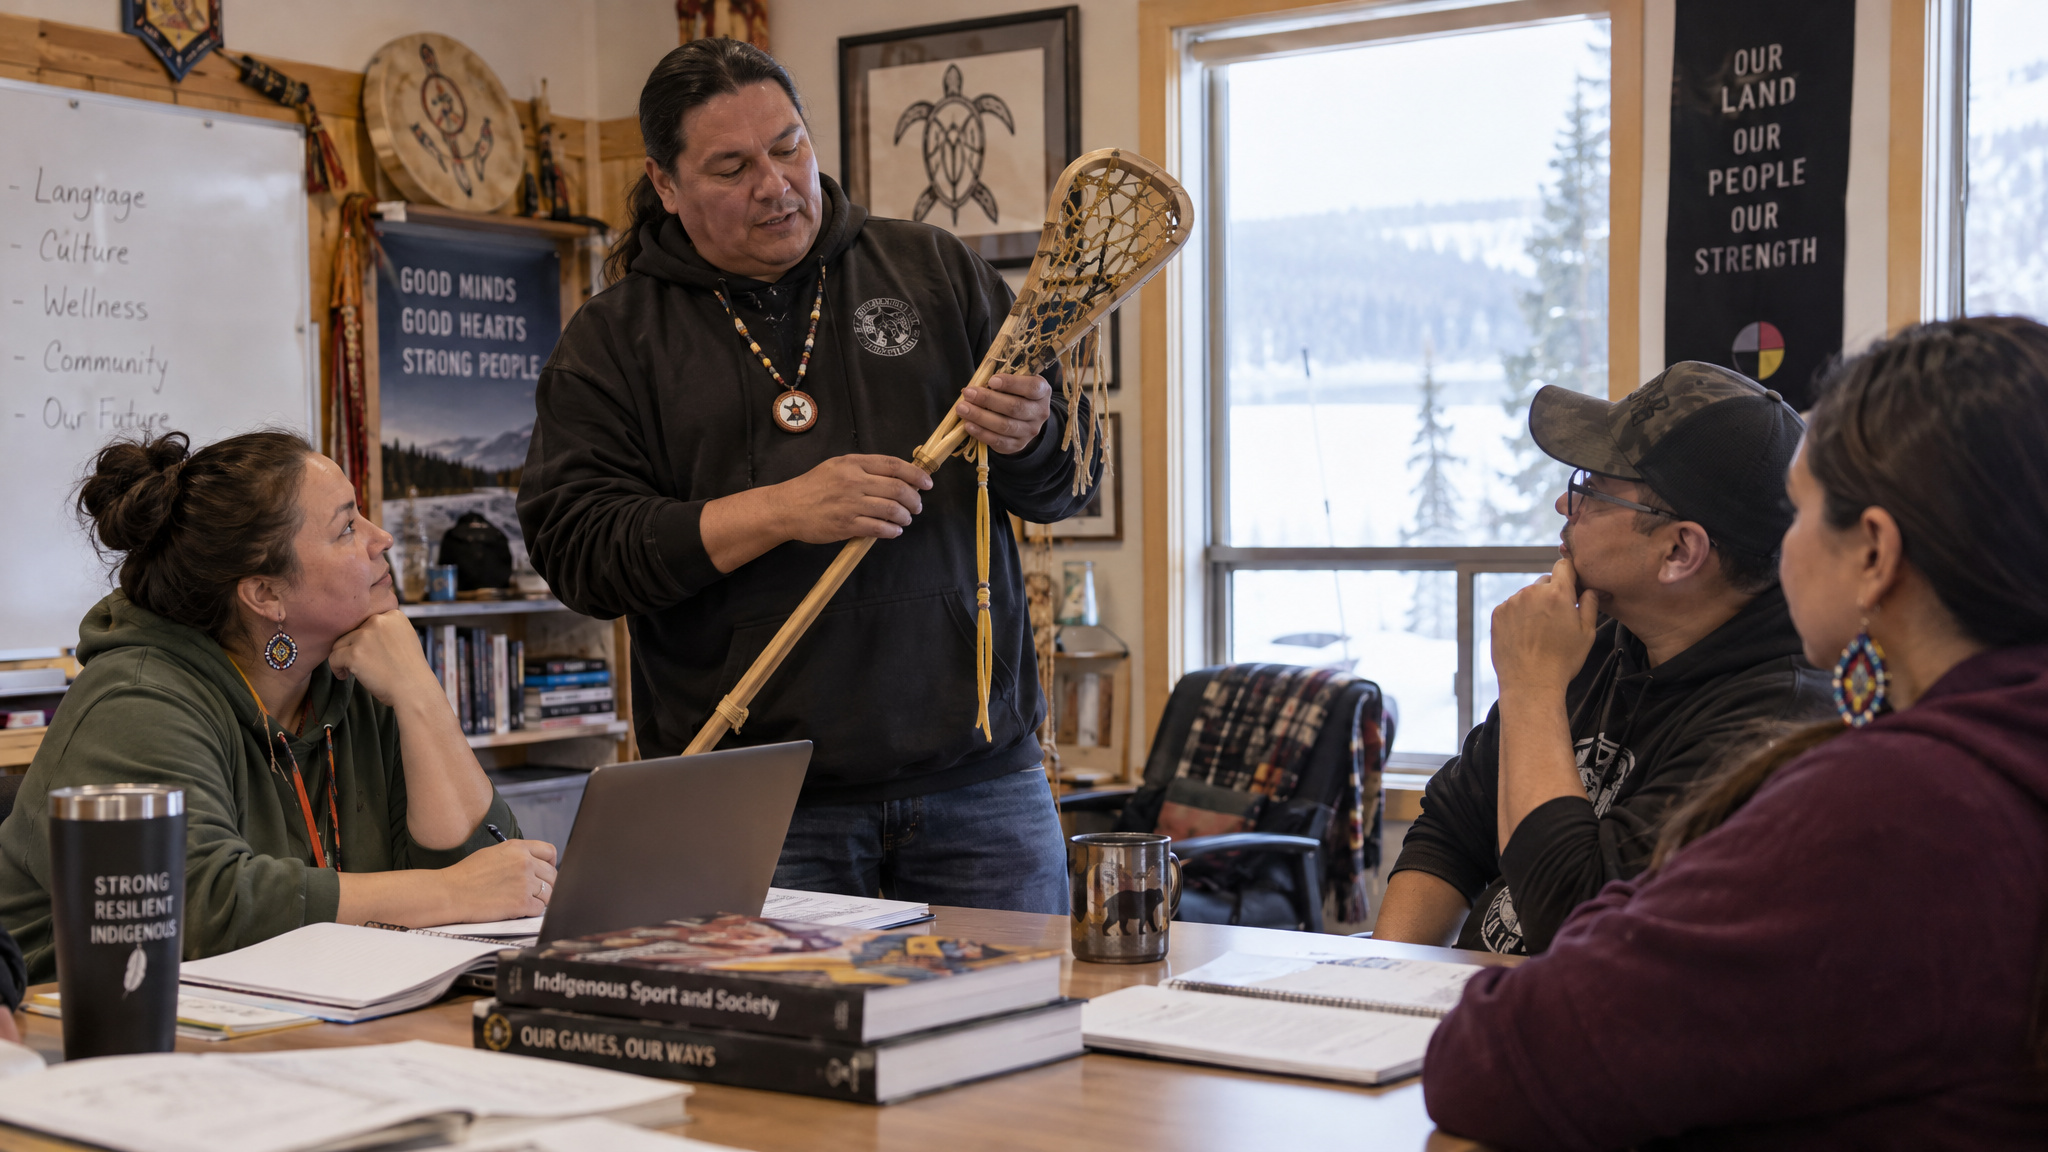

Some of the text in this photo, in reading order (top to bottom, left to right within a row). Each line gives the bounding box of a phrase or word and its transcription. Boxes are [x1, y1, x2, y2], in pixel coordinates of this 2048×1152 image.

[1734, 43, 1783, 76] OUR
[1721, 76, 1796, 114] LAND
[1733, 122, 1781, 155] OUR
[34, 166, 147, 223] Language
[1708, 157, 1806, 197] PEOPLE
[1731, 202, 1779, 233] OUR
[39, 228, 129, 265] Culture
[1695, 236, 1817, 275] STRENGTH
[43, 284, 149, 322] Wellness
[400, 266, 517, 303] GOOD MINDS
[401, 307, 527, 342] GOOD HEARTS
[43, 339, 168, 395] Community
[402, 347, 541, 380] STRONG PEOPLE
[43, 396, 170, 431] Our Future
[95, 871, 170, 895] STRONG
[95, 895, 174, 920] RESILIENT
[91, 919, 177, 944] INDIGENOUS
[533, 970, 628, 999] Indigenous
[630, 980, 678, 1007] Sport
[680, 987, 714, 1009] and
[715, 988, 780, 1021] Society
[520, 1026, 717, 1068] OUR GAMES, OUR WAYS
